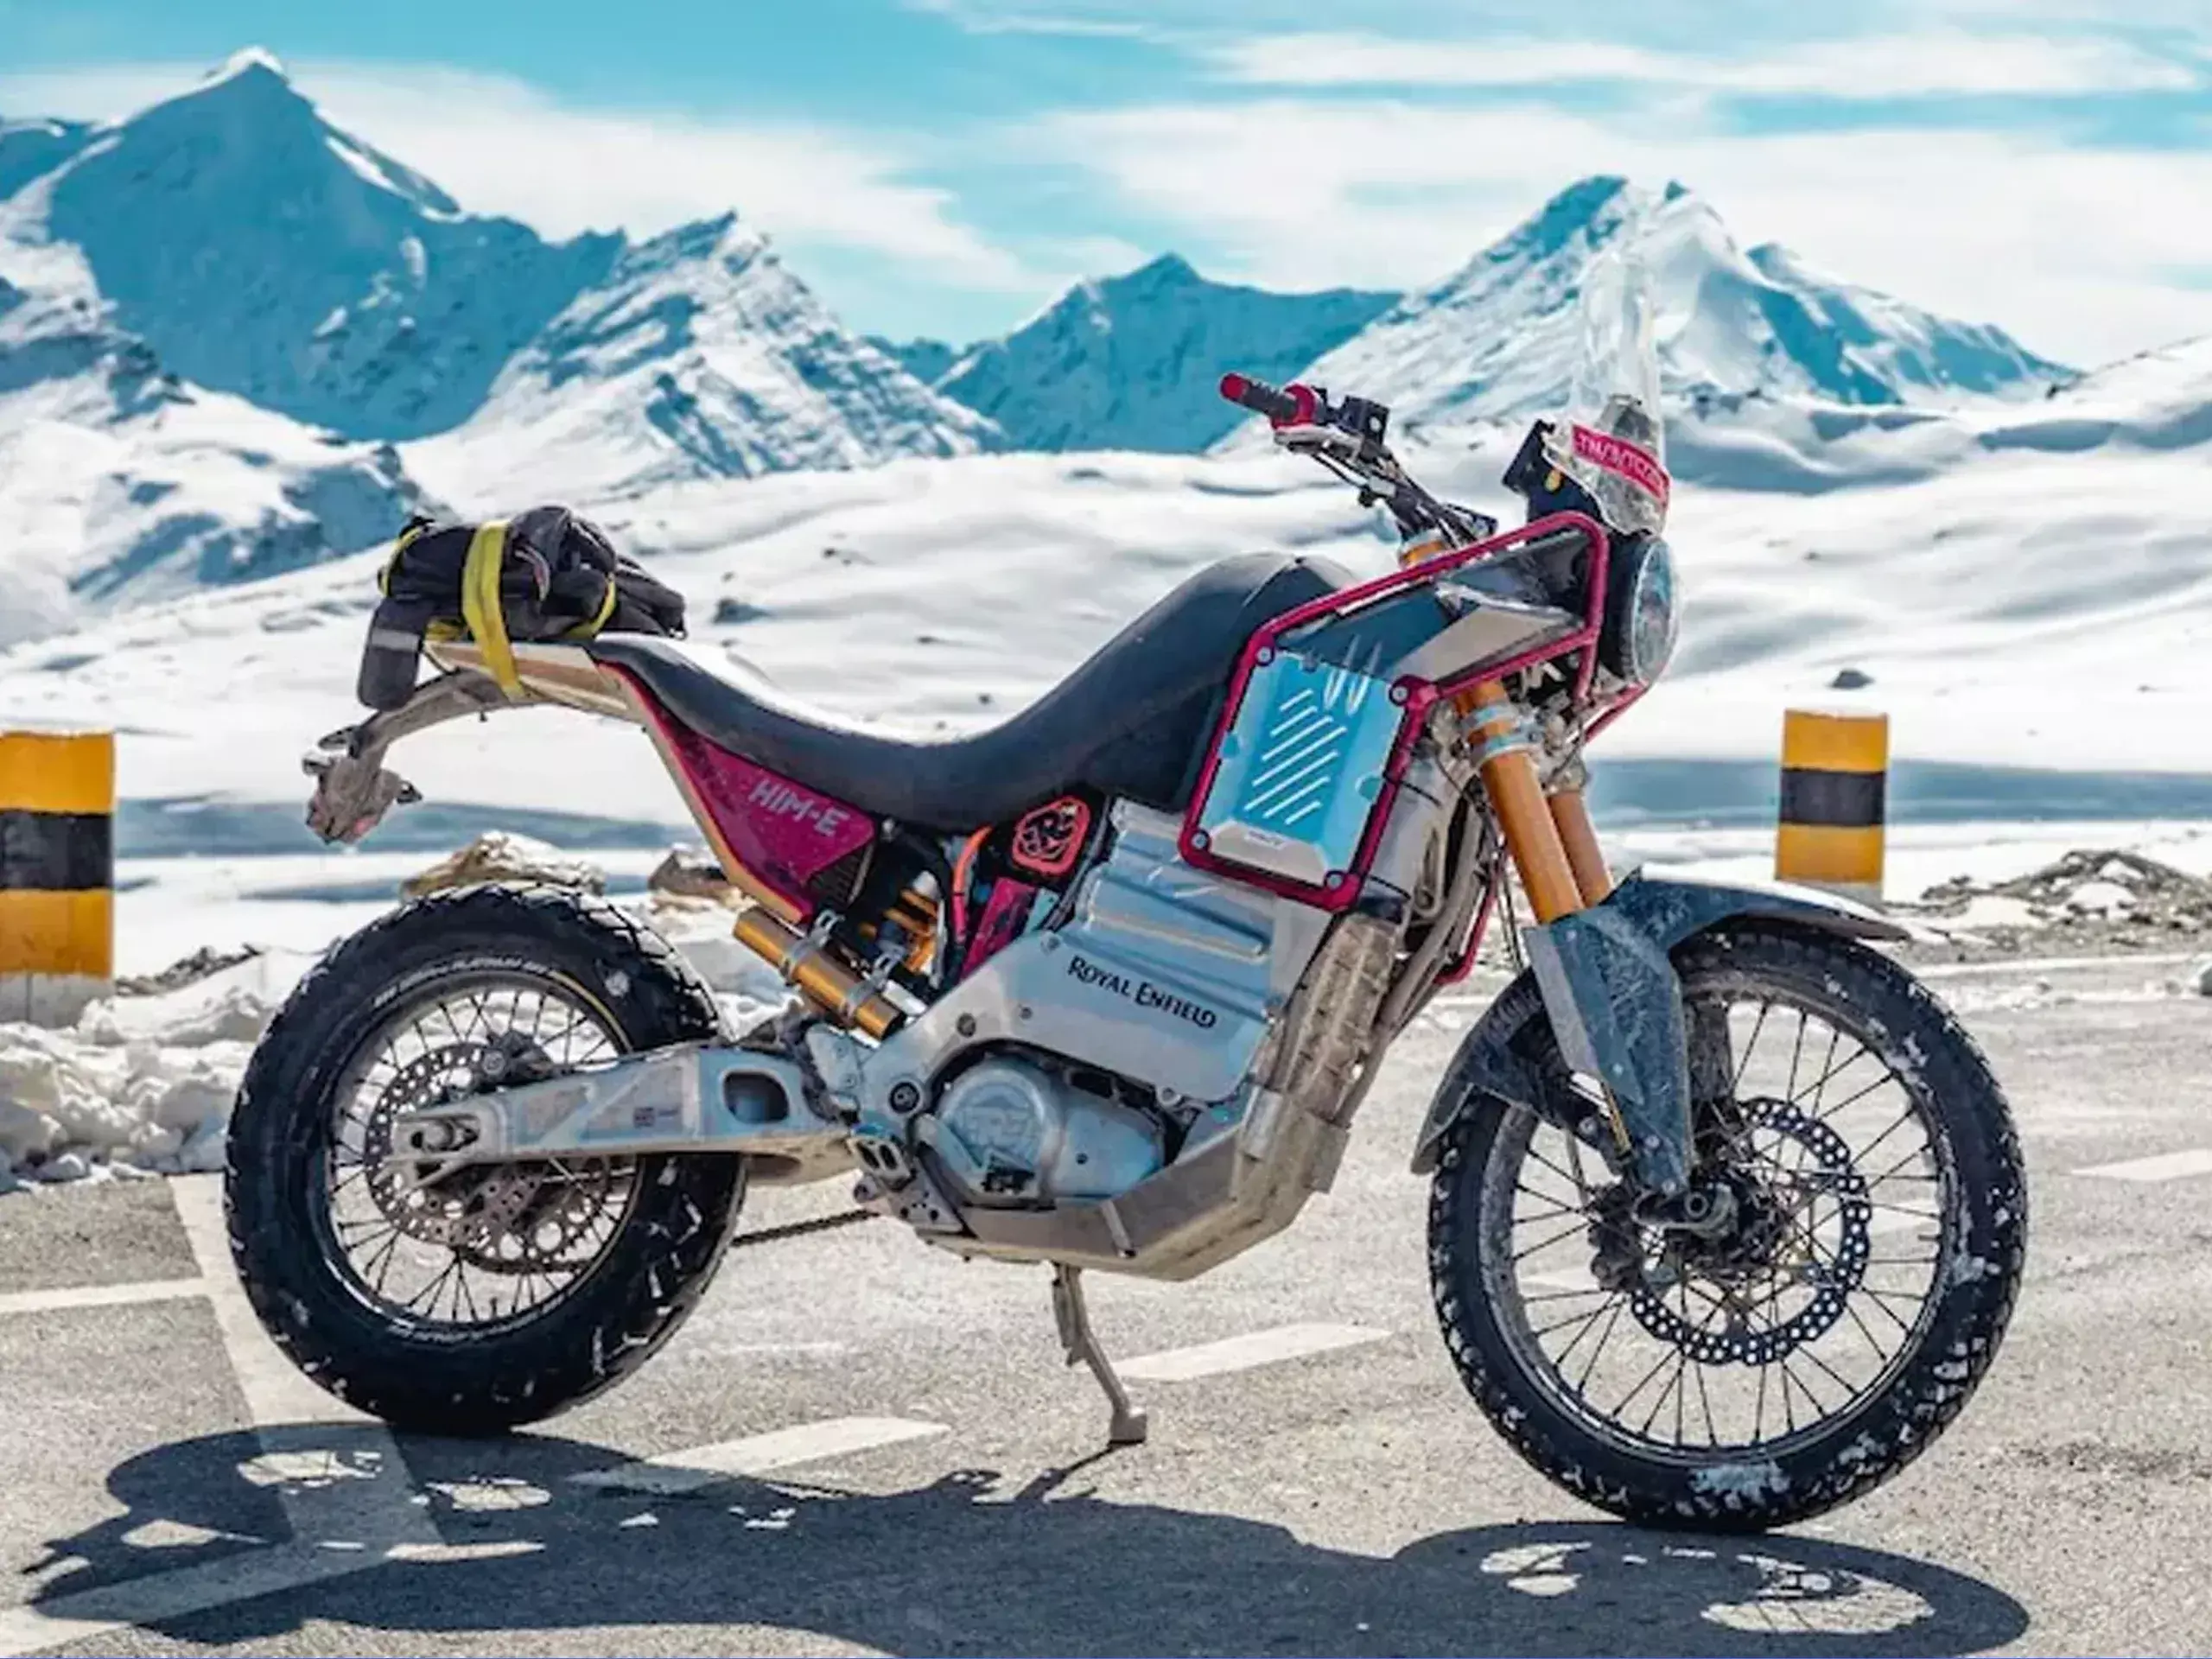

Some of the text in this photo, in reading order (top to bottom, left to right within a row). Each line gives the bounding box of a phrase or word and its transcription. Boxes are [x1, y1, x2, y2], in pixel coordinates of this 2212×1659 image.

[748, 779, 850, 836] HIM-E
[1067, 955, 1217, 1029] ROYAL ENFIELD
